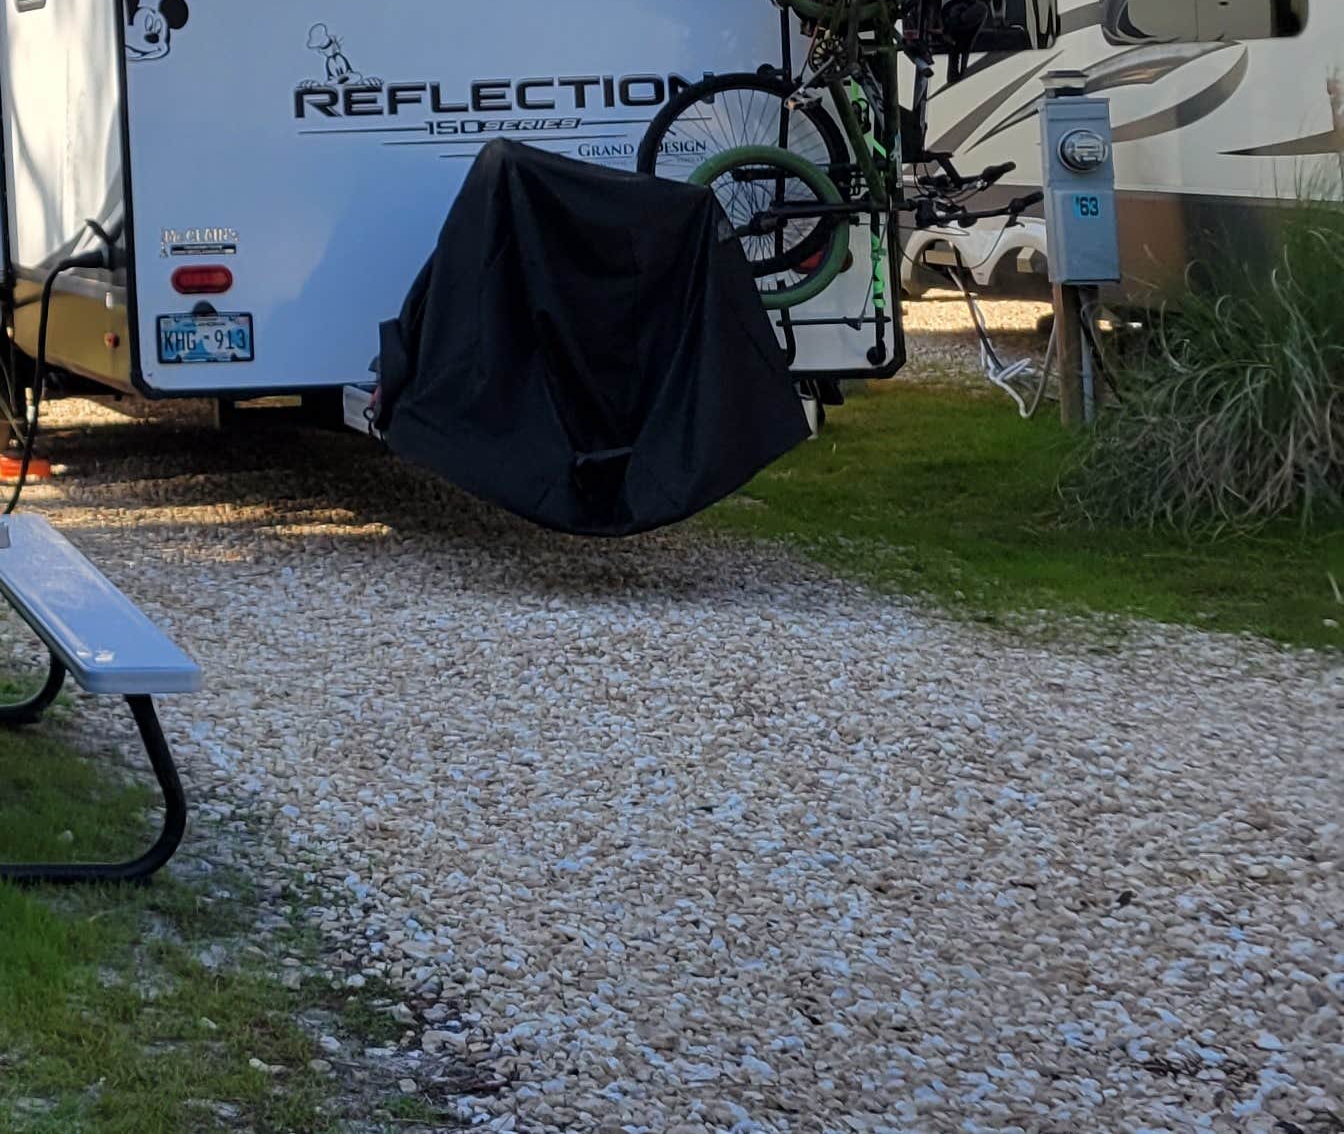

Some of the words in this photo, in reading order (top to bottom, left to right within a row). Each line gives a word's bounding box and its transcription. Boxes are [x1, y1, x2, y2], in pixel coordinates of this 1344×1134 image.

[424, 120, 480, 135] 150
[481, 118, 583, 132] SERIES
[577, 142, 635, 158] GRAND
